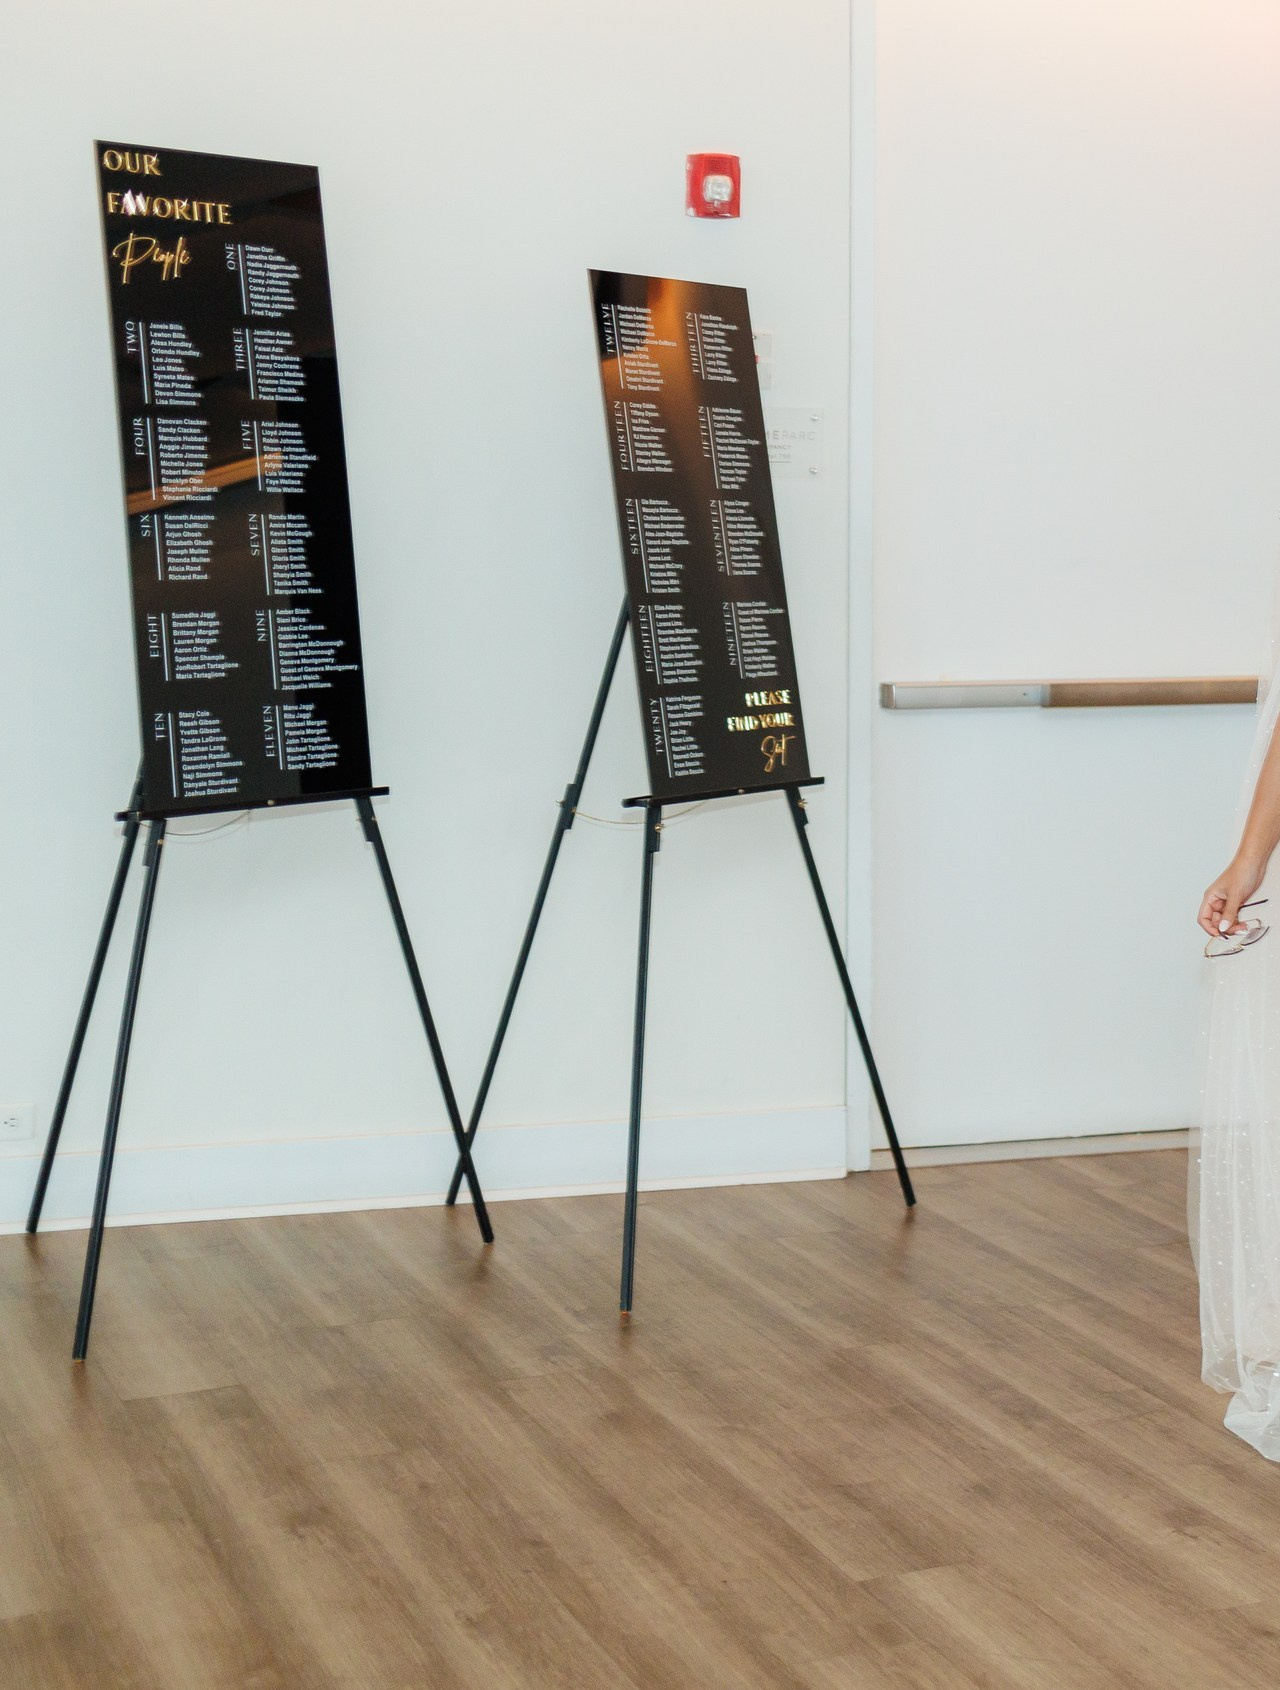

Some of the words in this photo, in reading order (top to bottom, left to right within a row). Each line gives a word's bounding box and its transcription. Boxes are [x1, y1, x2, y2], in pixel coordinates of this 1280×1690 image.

[103, 150, 162, 176] OUR
[107, 189, 233, 225] FAVORITE
[112, 230, 192, 285] People
[225, 243, 235, 270] ONE
[126, 322, 136, 353] TWO
[233, 328, 244, 371] THREE
[601, 303, 613, 354] TWELVE
[686, 312, 700, 374] THIRTEEN
[133, 418, 144, 455] FOUR
[241, 421, 252, 449] FIVE
[614, 401, 629, 470] FOURTEEN
[698, 406, 711, 457] FIFTEEN
[140, 514, 152, 537] SIX
[248, 514, 260, 556] SEVEN
[626, 499, 639, 554] SIXTEEN
[710, 500, 724, 572] SEVENTEEN
[147, 614, 159, 657] EIGHT
[256, 610, 267, 641] NINE
[638, 606, 653, 672] EIGHTEEN
[723, 603, 736, 665] NINETEEN
[745, 690, 792, 707] PLEASE
[154, 714, 165, 741] TEN
[263, 706, 275, 756] ELEVEN
[650, 698, 664, 755] TWENTY
[727, 716, 759, 731] FIND
[759, 712, 795, 728] YOUR
